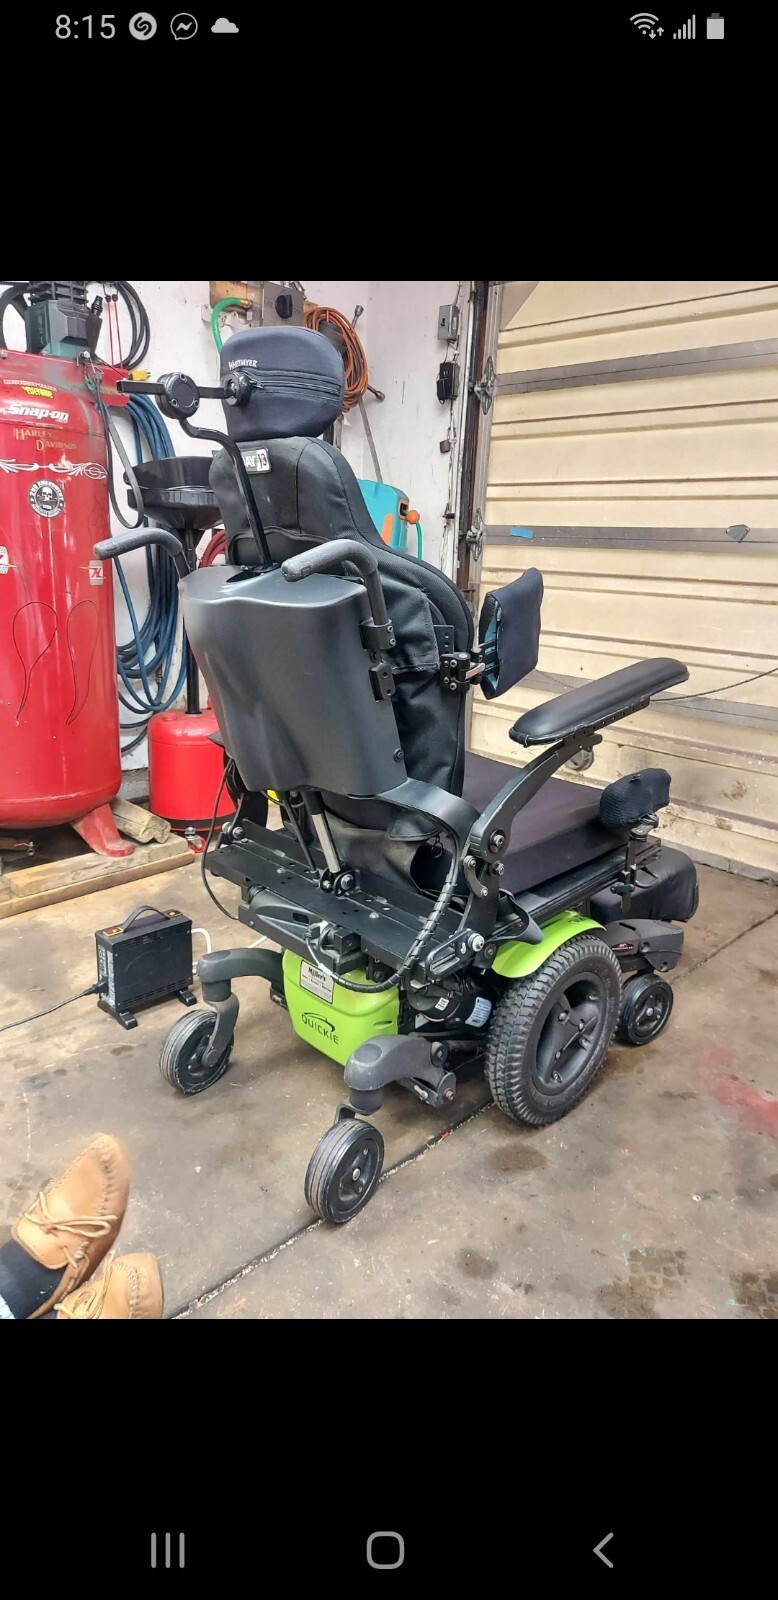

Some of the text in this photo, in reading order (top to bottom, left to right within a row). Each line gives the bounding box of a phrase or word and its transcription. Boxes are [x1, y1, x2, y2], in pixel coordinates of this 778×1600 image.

[9, 403, 70, 423] Snap-on
[15, 428, 53, 440] HARLEY
[36, 439, 77, 450] DAVIDSON
[301, 1014, 339, 1045] QUICKIE
